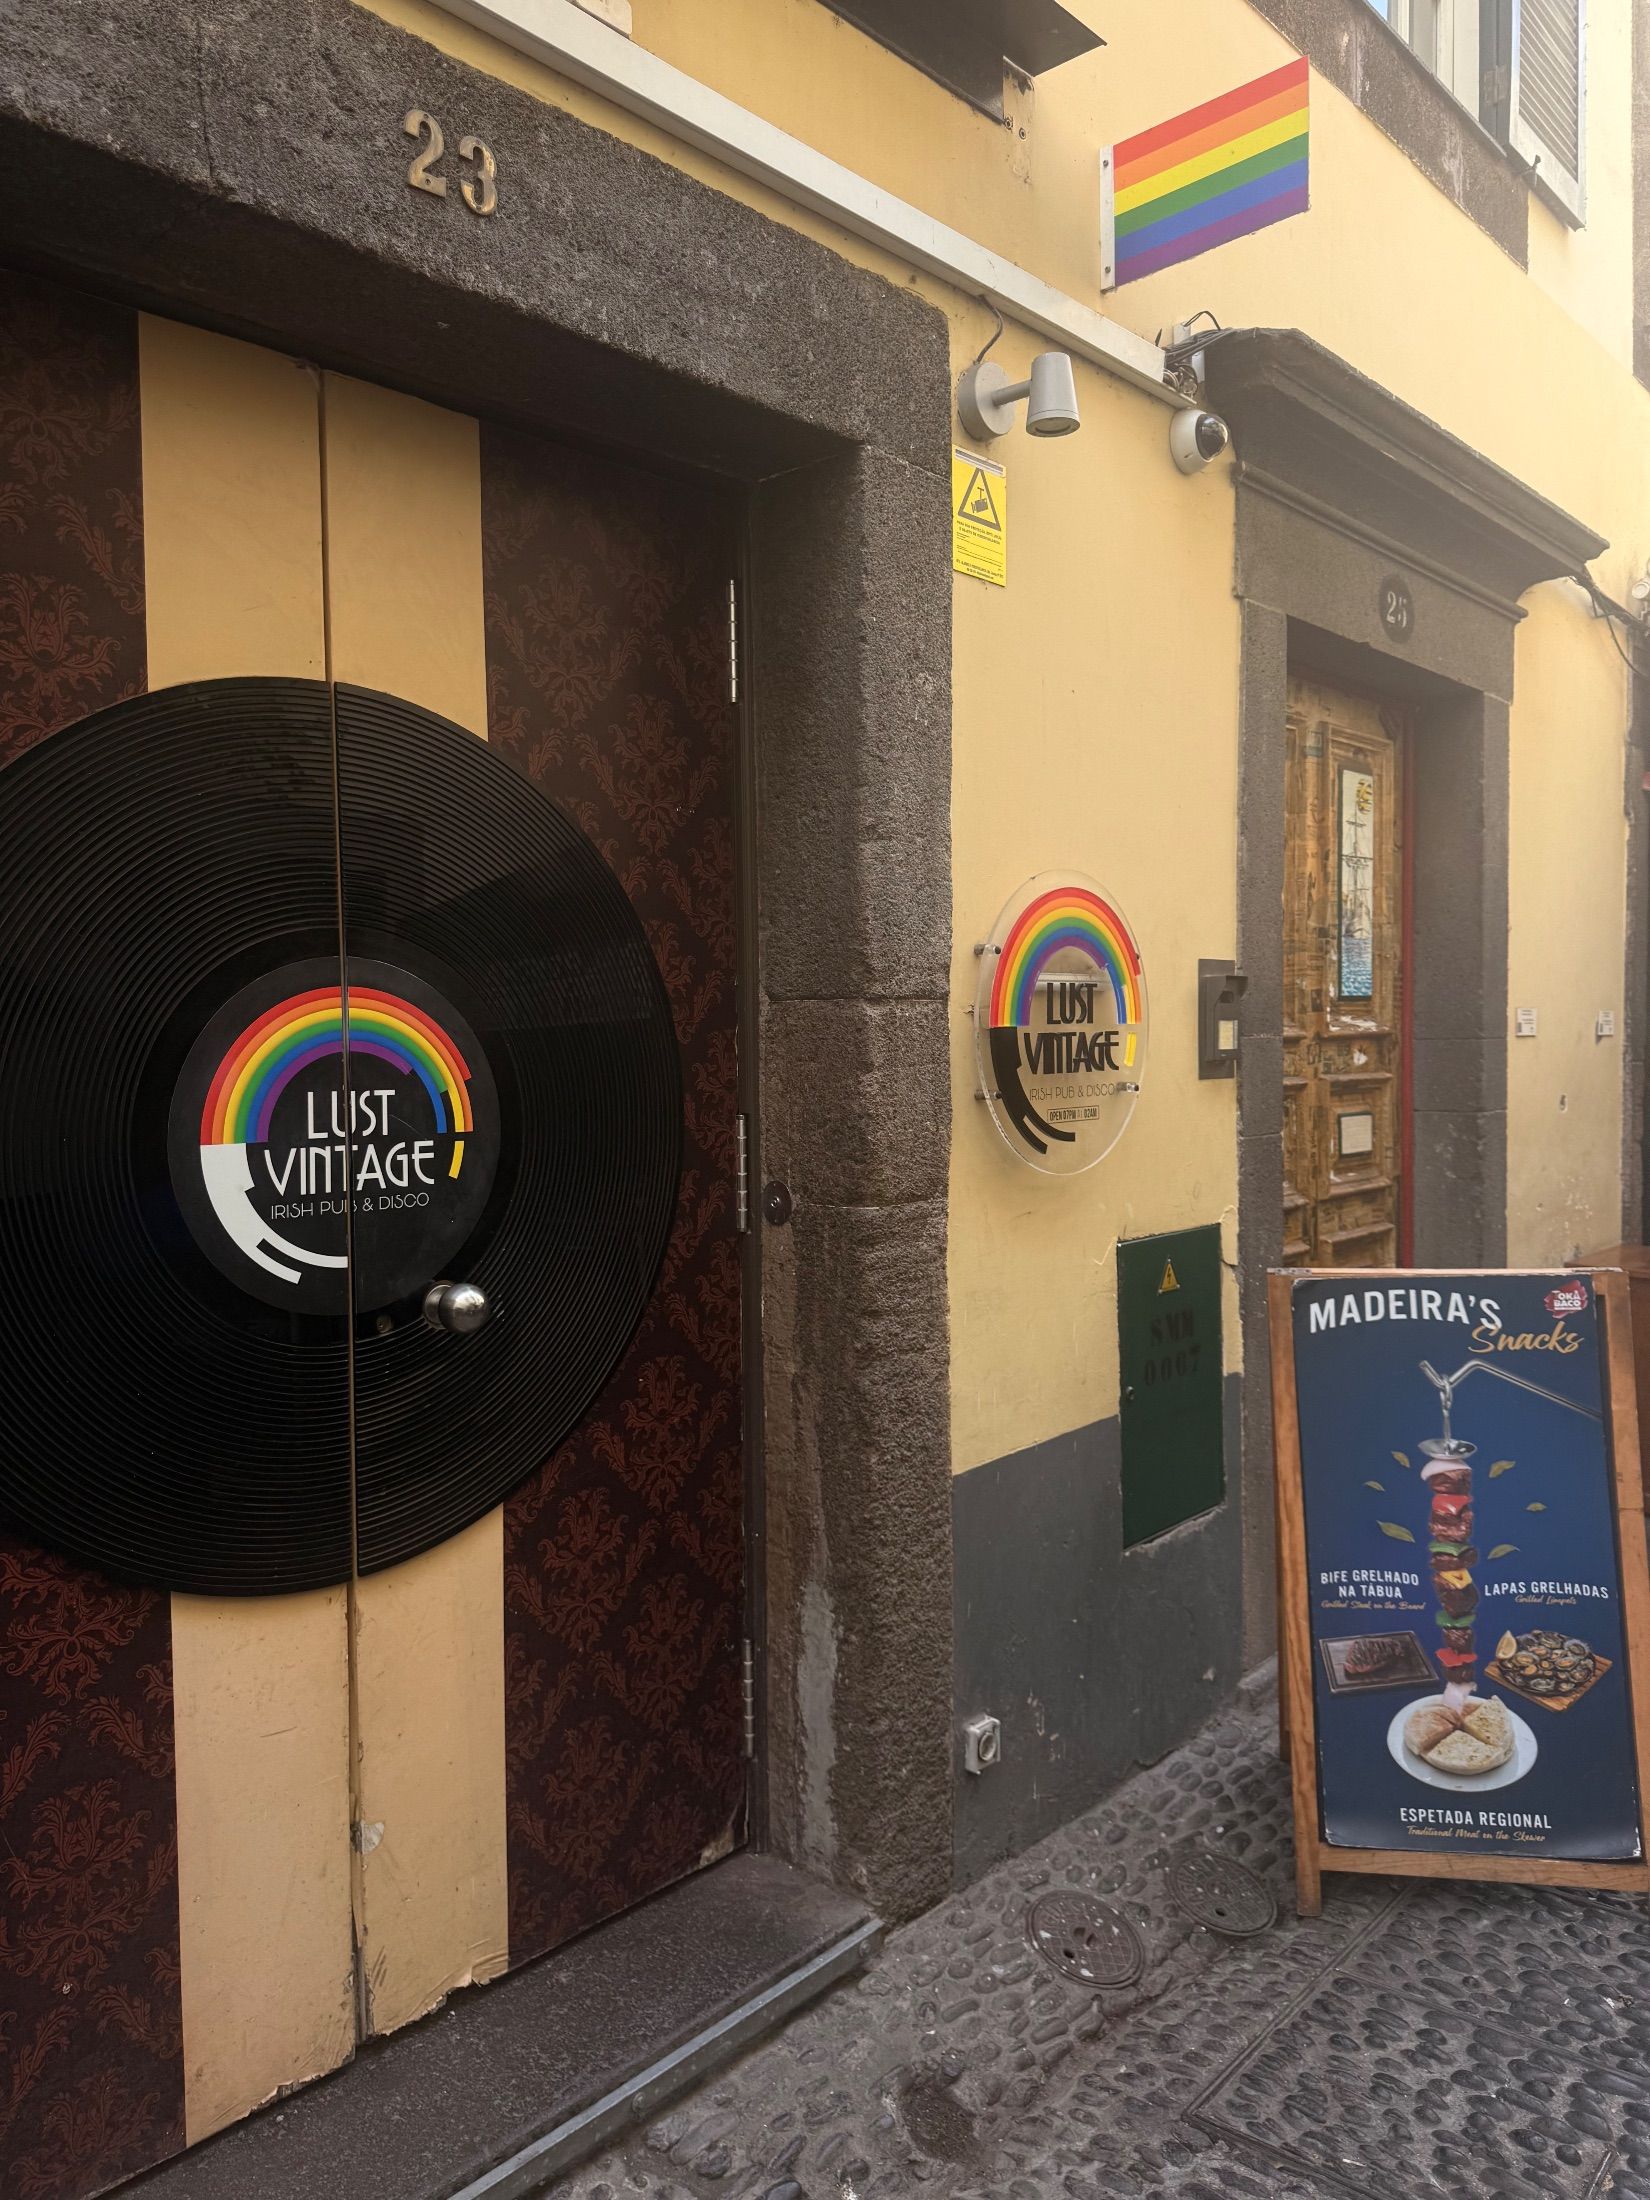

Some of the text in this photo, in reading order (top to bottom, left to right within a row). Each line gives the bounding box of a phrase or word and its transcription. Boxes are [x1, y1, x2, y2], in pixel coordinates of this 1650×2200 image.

[403, 109, 497, 216] 23
[1046, 982, 1098, 1024] LUST
[1023, 1031, 1120, 1075] VINTAGE
[1029, 1082, 1115, 1101] IRISH PUB & DISCO
[307, 1089, 396, 1140] LUST
[264, 1139, 435, 1197] VINTAGE
[271, 1202, 314, 1220] IRISH
[362, 1197, 374, 1212] &
[378, 1192, 430, 1210] DISCO
[1309, 1288, 1503, 1333] MADEIRA'S
[1467, 1320, 1585, 1353] Snacks
[1320, 1569, 1419, 1586] BIFE GRELHADO
[1338, 1584, 1356, 1598] NA
[1484, 1581, 1609, 1599] LAPAS GRELHADAS
[1399, 1807, 1552, 1829] ESPETADA REGIONAL
